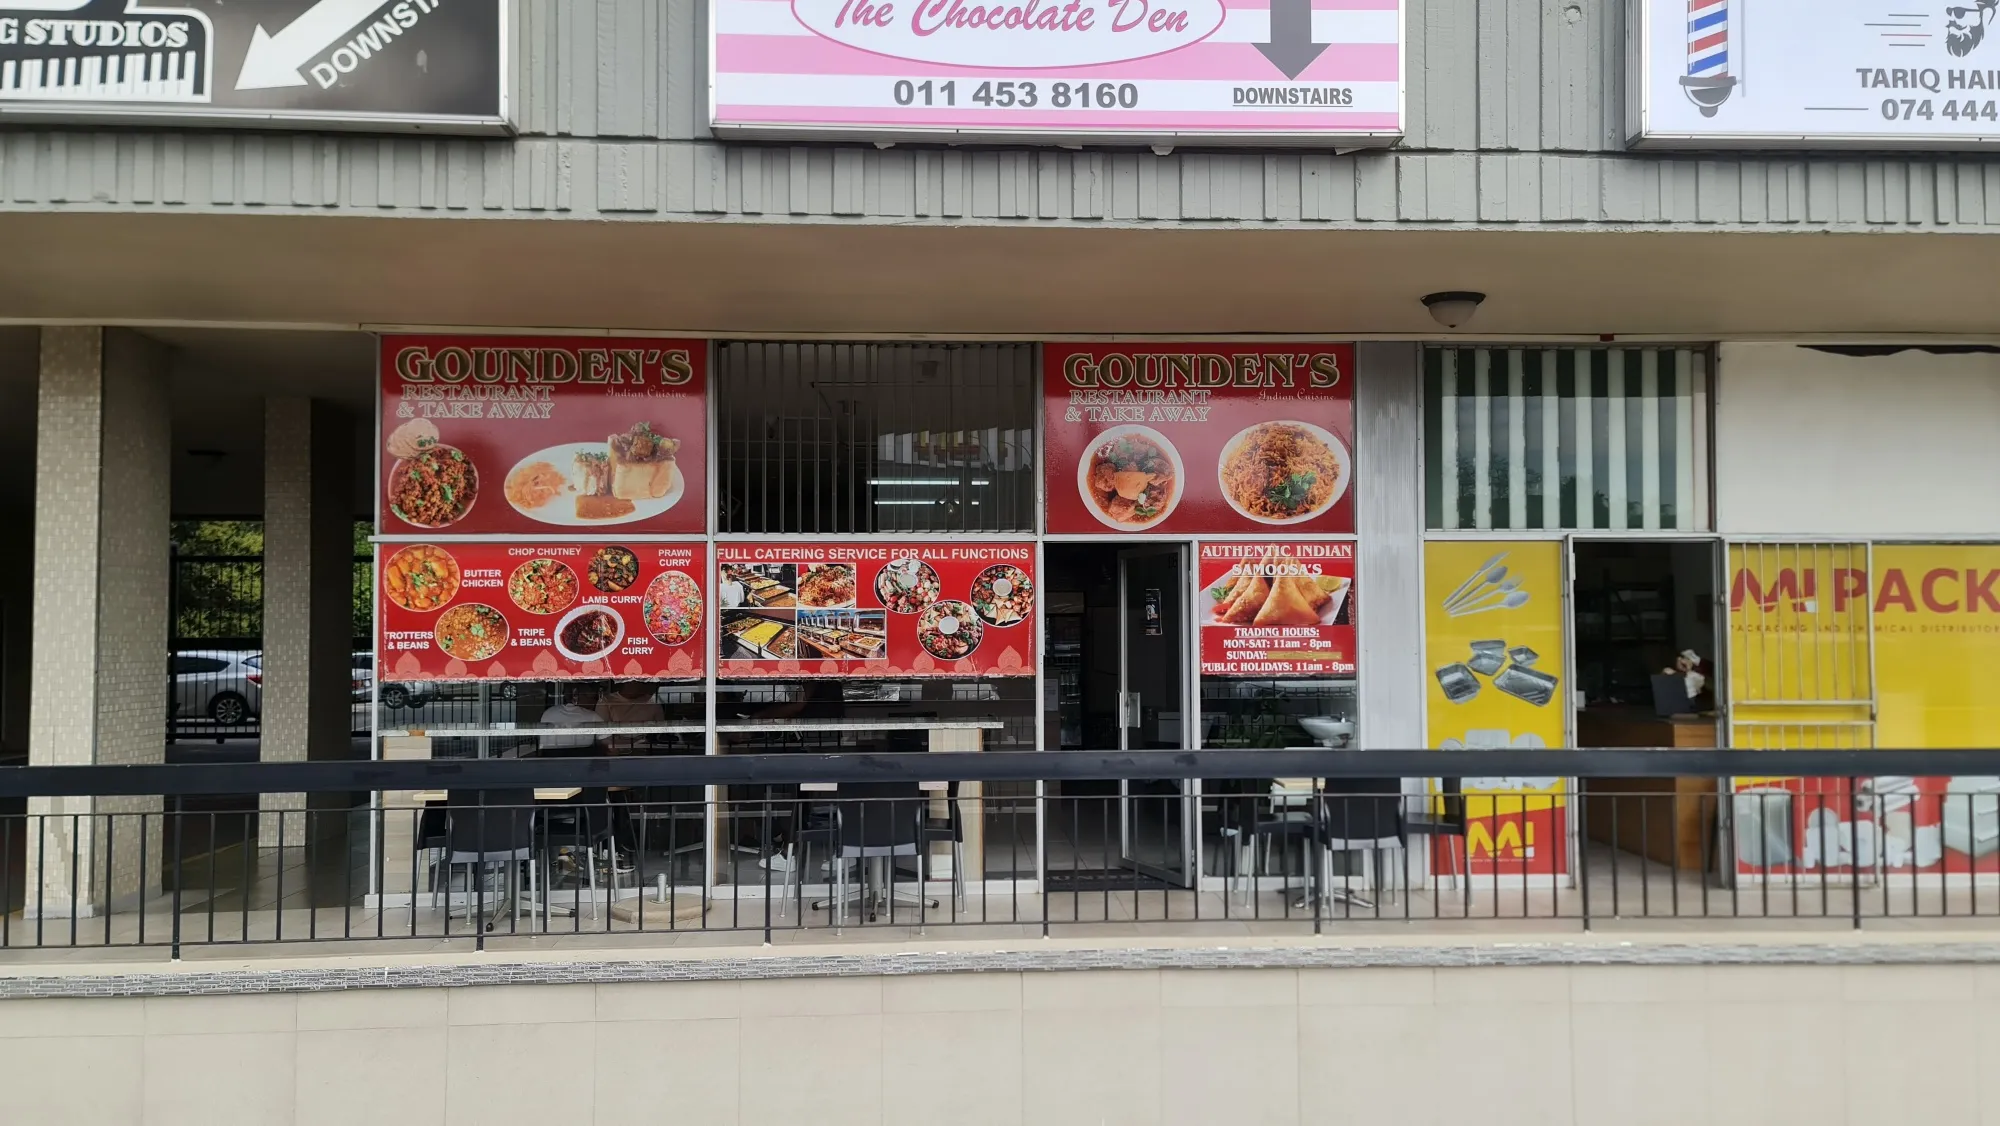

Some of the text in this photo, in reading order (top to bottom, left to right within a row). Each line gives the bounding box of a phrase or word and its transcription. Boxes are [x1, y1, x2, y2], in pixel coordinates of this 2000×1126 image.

[911, 0, 1095, 37] Chocolate
[1099, 0, 1189, 33] Den
[24, 19, 189, 48] STUDIOS
[309, 0, 440, 90] DOWNST
[1856, 68, 2000, 94] TARIQ HAI
[893, 80, 1139, 109] 011 453 8160
[1232, 87, 1353, 106] DOWNSTAIRS
[1881, 98, 1998, 122] 074 444
[395, 346, 693, 385] GOUNDEN'S
[1063, 352, 1340, 388] GOUNDEN'S
[402, 384, 555, 402] RESTAURANT
[605, 384, 688, 399] Indian Cuisine
[1070, 389, 1211, 405] RESTAURANT
[1258, 388, 1335, 402] Indian Cuisine
[396, 402, 555, 419] & TAKE AWAY
[1065, 406, 1211, 422] & TAKE AWAY
[508, 547, 582, 557] CHOP CHUTNEY
[658, 549, 692, 557] PRAWN
[716, 548, 1029, 560] FULL CATERING SERVICE FOR ALL FUNCTIONS
[1201, 545, 1352, 557] AUTHENTIC INDIAN
[659, 558, 691, 567] CURRY
[464, 569, 502, 578] BUTTER
[1231, 563, 1323, 576] SAMOOSA'S
[461, 578, 504, 588] CHICKEN
[1833, 567, 2000, 613] PACK
[582, 595, 643, 604] LAMB CURRY
[386, 631, 434, 640] TROTTERS
[517, 628, 545, 637] TRIPE
[1234, 627, 1320, 637] TRADING HOURS:
[387, 640, 430, 649] & BEANS
[510, 638, 552, 647] & BEANS
[627, 637, 648, 645] FISH
[1223, 639, 1271, 648] MON-SAT:
[1273, 639, 1300, 648] 11am
[1309, 639, 1332, 650] 8pm
[621, 646, 654, 656] CURRY
[1226, 651, 1267, 660] SUNDAY:
[1201, 662, 1238, 671] PUBLIC
[1240, 662, 1293, 671] HOLIDAYS:
[1296, 662, 1323, 671] 11am
[1332, 662, 1354, 673] 8pm
